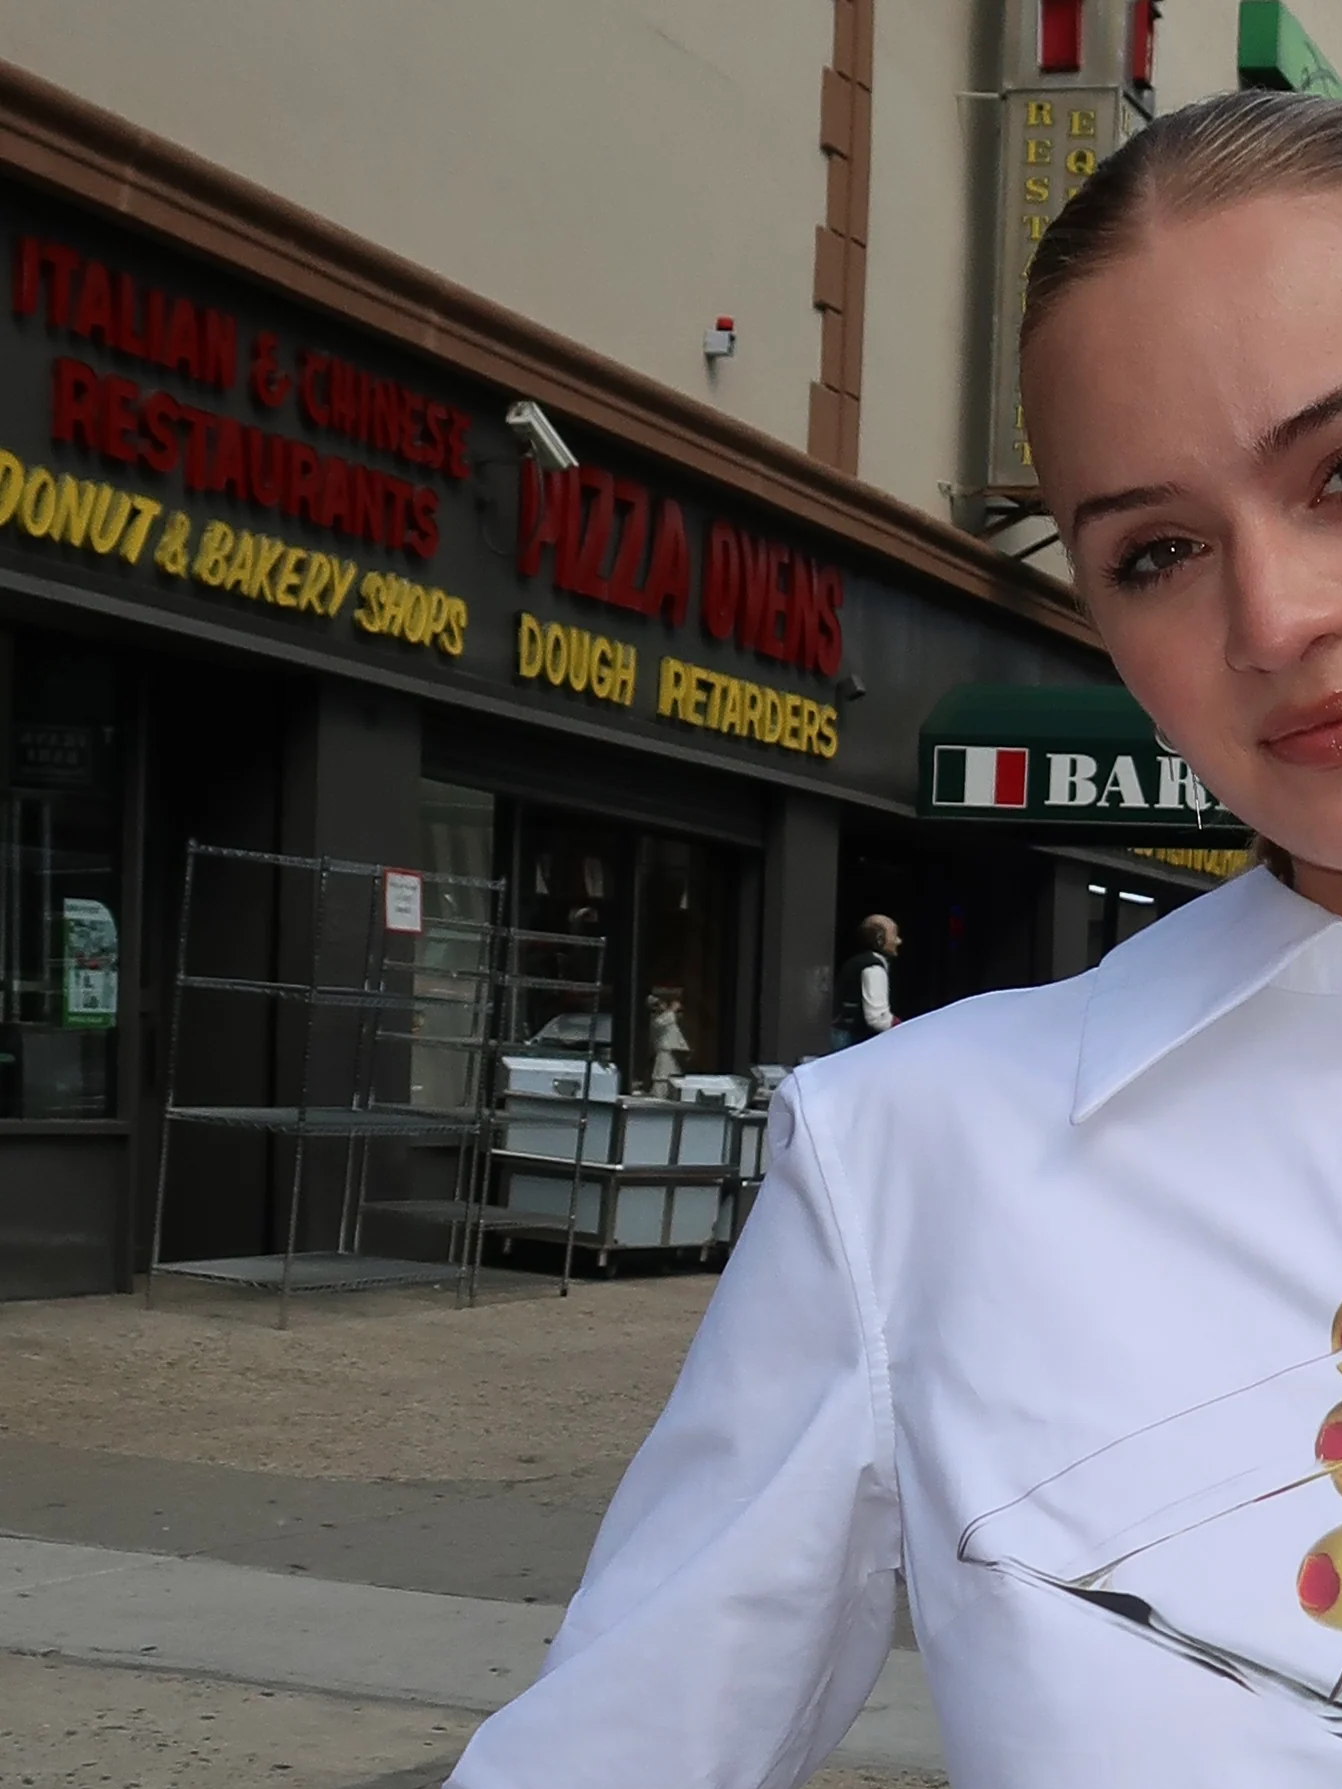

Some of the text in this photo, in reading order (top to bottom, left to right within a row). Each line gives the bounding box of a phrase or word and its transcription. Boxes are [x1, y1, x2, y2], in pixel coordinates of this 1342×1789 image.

[13, 235, 472, 480] ITALIAN & CHINESE
[52, 357, 440, 559] RESTAURANTS
[0, 449, 468, 656] DONUT & BAKERY SHOPS
[517, 455, 844, 677] PIZZA OVENS
[518, 612, 838, 759] DOUGH RETARDERS
[1044, 753, 1228, 811] BAR
